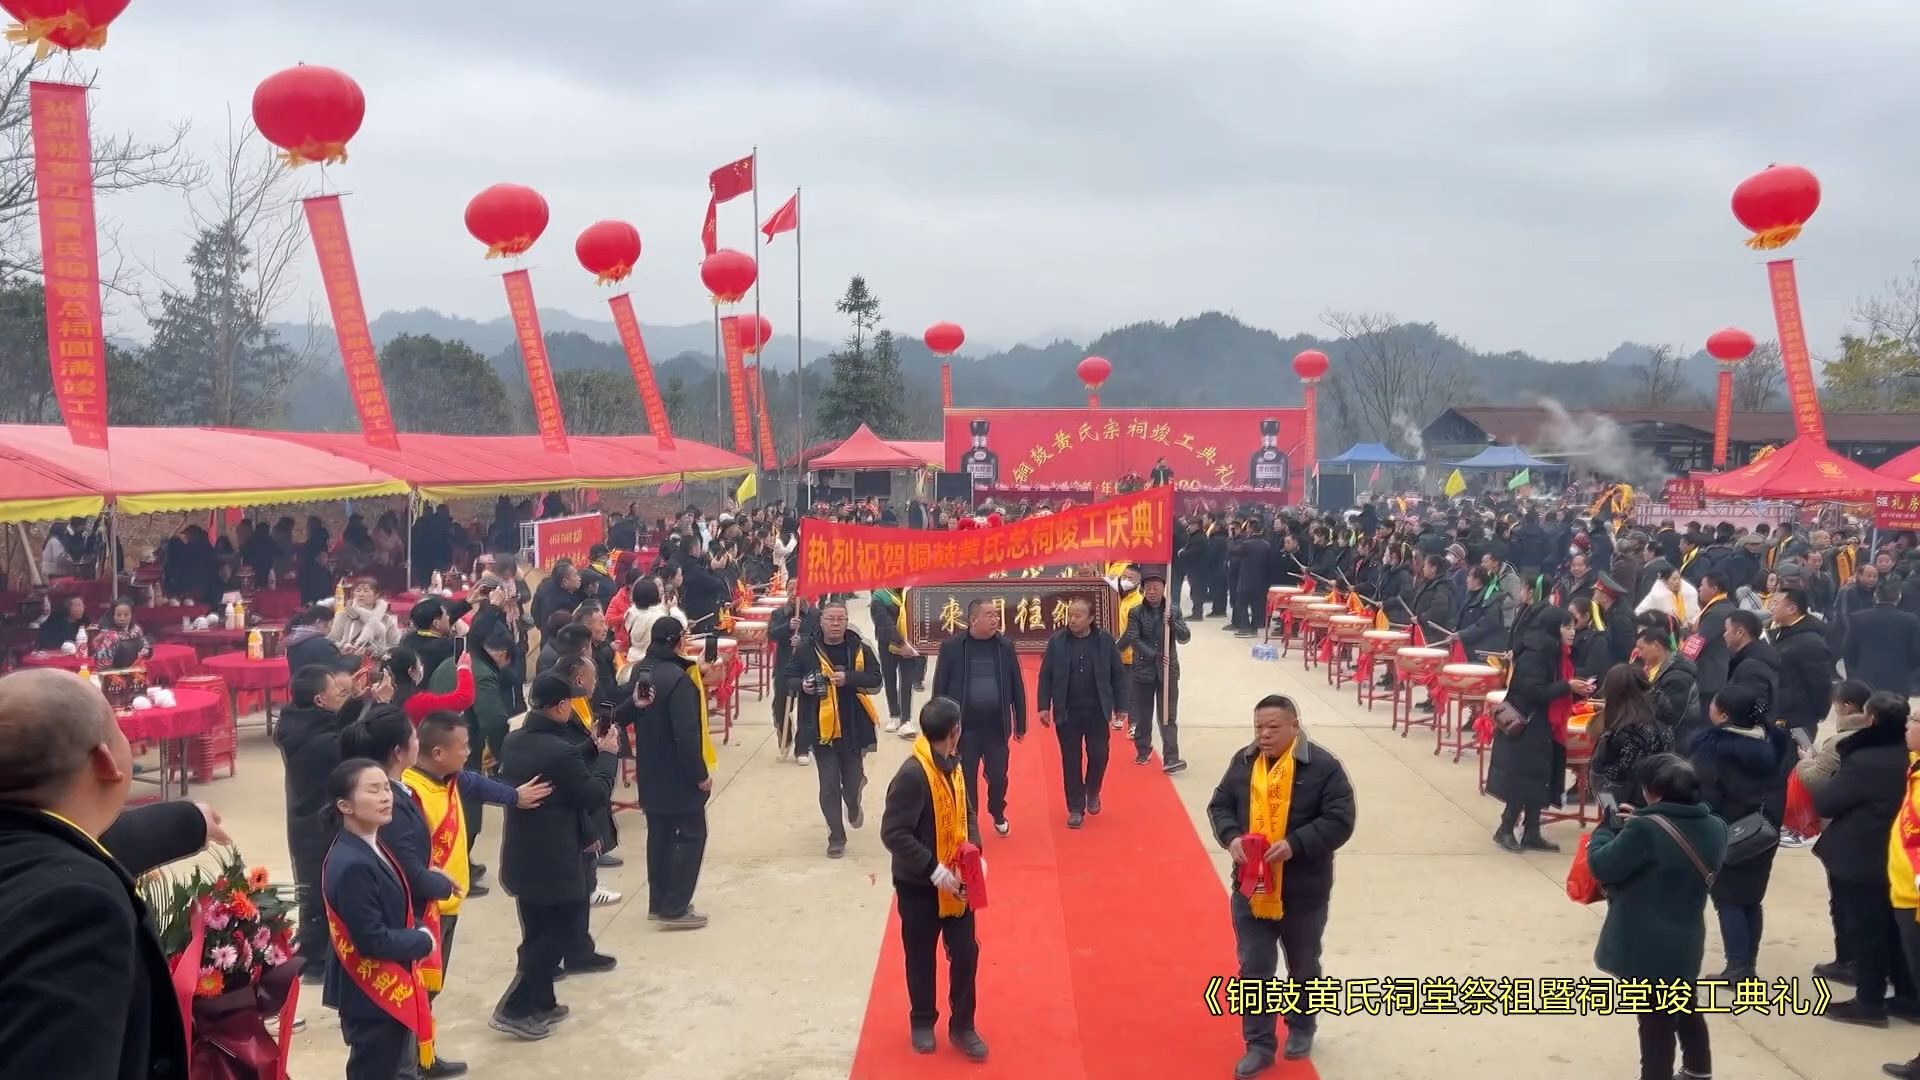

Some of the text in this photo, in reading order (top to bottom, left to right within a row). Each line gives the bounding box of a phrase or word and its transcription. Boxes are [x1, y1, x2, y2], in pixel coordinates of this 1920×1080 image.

[1012, 416, 1236, 487] 铜鼓黄氏宗祠竣工典礼
